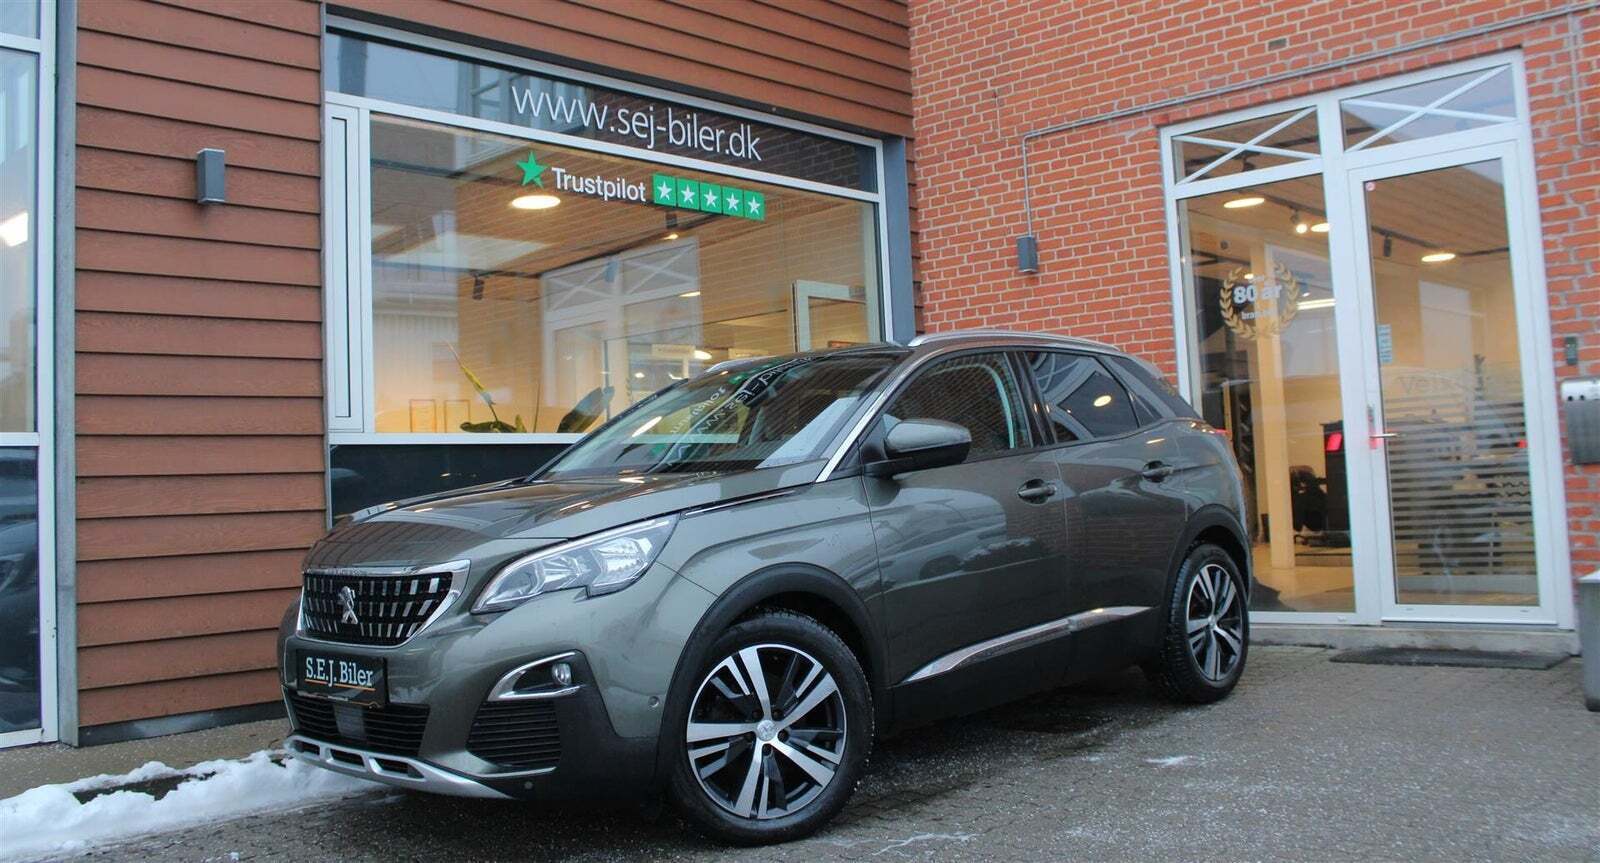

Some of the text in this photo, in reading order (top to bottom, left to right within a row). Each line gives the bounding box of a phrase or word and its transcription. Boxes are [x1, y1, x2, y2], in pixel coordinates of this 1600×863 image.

[511, 86, 762, 161] www.sej-biler.dk
[551, 167, 646, 202] Trustpilot
[1233, 285, 1257, 304] 80
[305, 656, 374, 687] S.E.J. Biler
